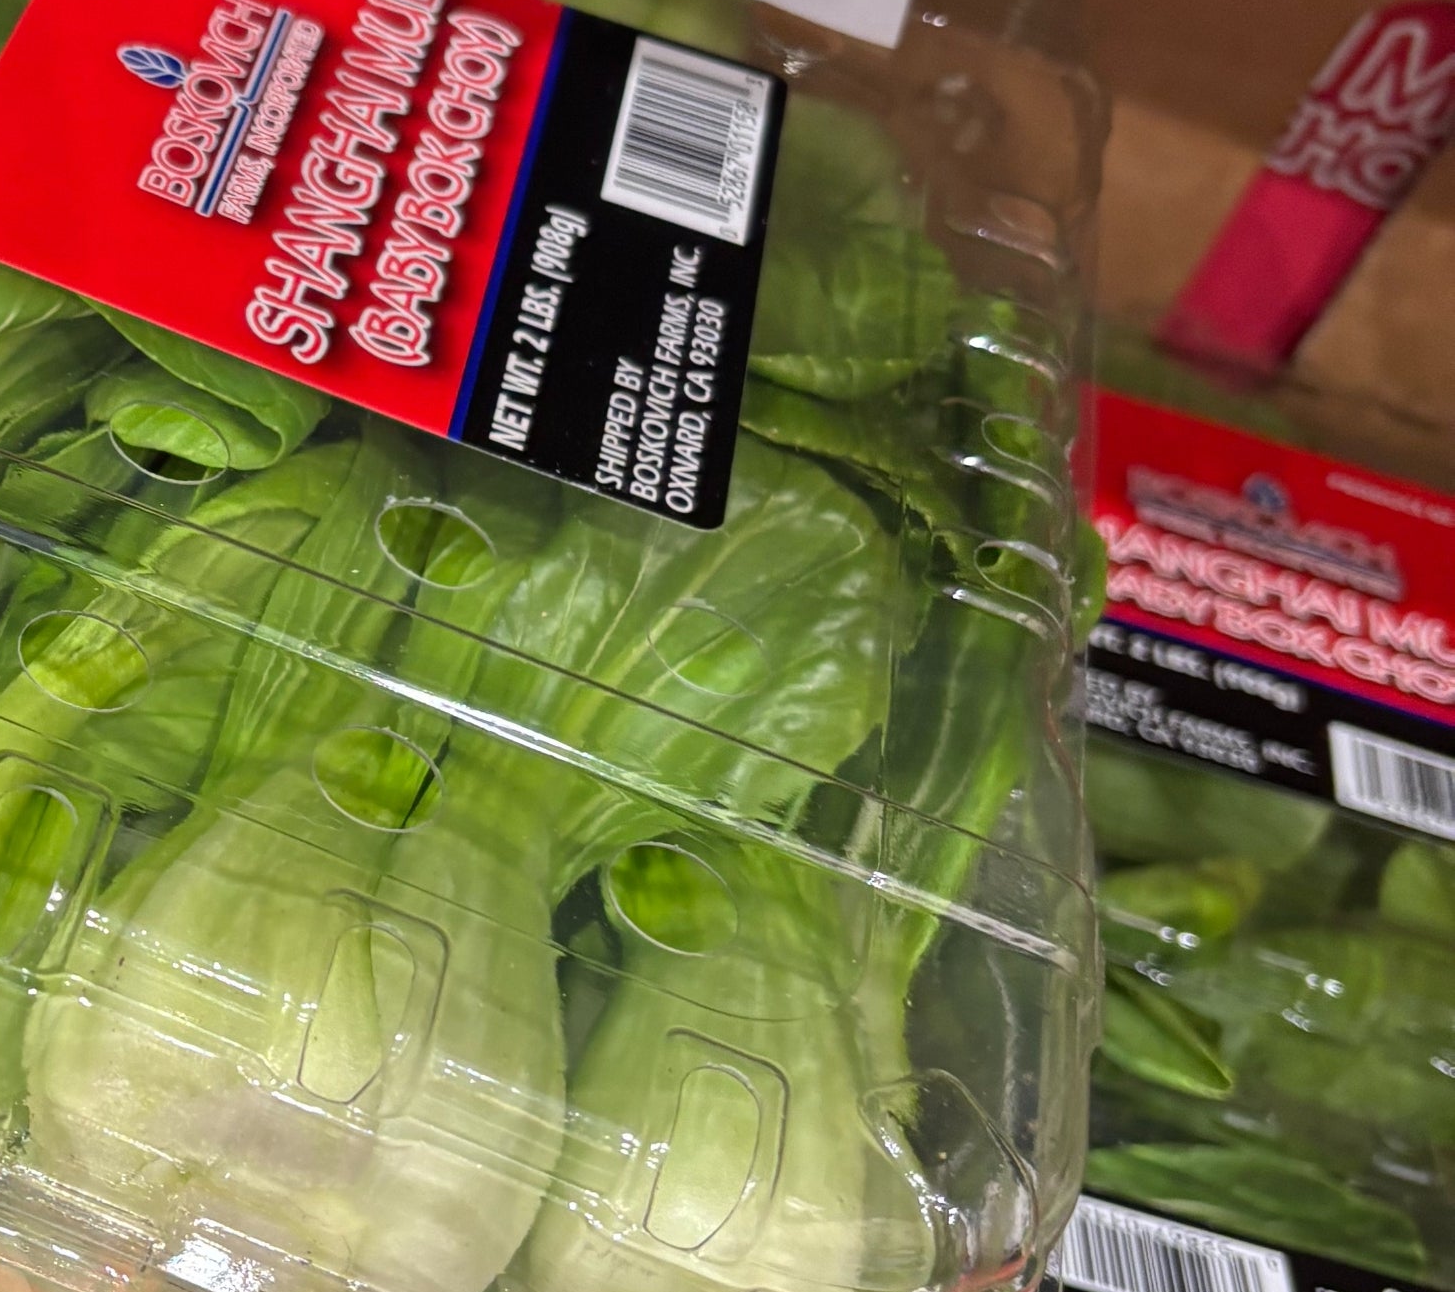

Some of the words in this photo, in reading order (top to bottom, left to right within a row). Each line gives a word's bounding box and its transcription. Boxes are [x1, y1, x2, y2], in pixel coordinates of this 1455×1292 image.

[245, 17, 326, 157] INCORPORATED
[427, 11, 524, 142] CHOY)
[216, 155, 276, 226] FARMS,
[245, 67, 409, 367] SHANGHAI
[394, 129, 486, 239] BOK
[719, 156, 750, 212] 52867
[531, 204, 590, 284] (908g)
[668, 243, 703, 289] INC.
[348, 217, 454, 367] (BABY
[517, 282, 563, 333] LBS.
[654, 291, 696, 366] FARMS,
[512, 328, 550, 354] 2
[689, 299, 726, 368] 93030
[501, 350, 545, 397] WT.
[613, 355, 645, 393] BY
[684, 369, 715, 405] CA
[488, 392, 534, 452] NET
[594, 390, 637, 490] SHIPPED
[629, 364, 680, 504] BOSKOVICH
[665, 410, 714, 515] OXNARD,
